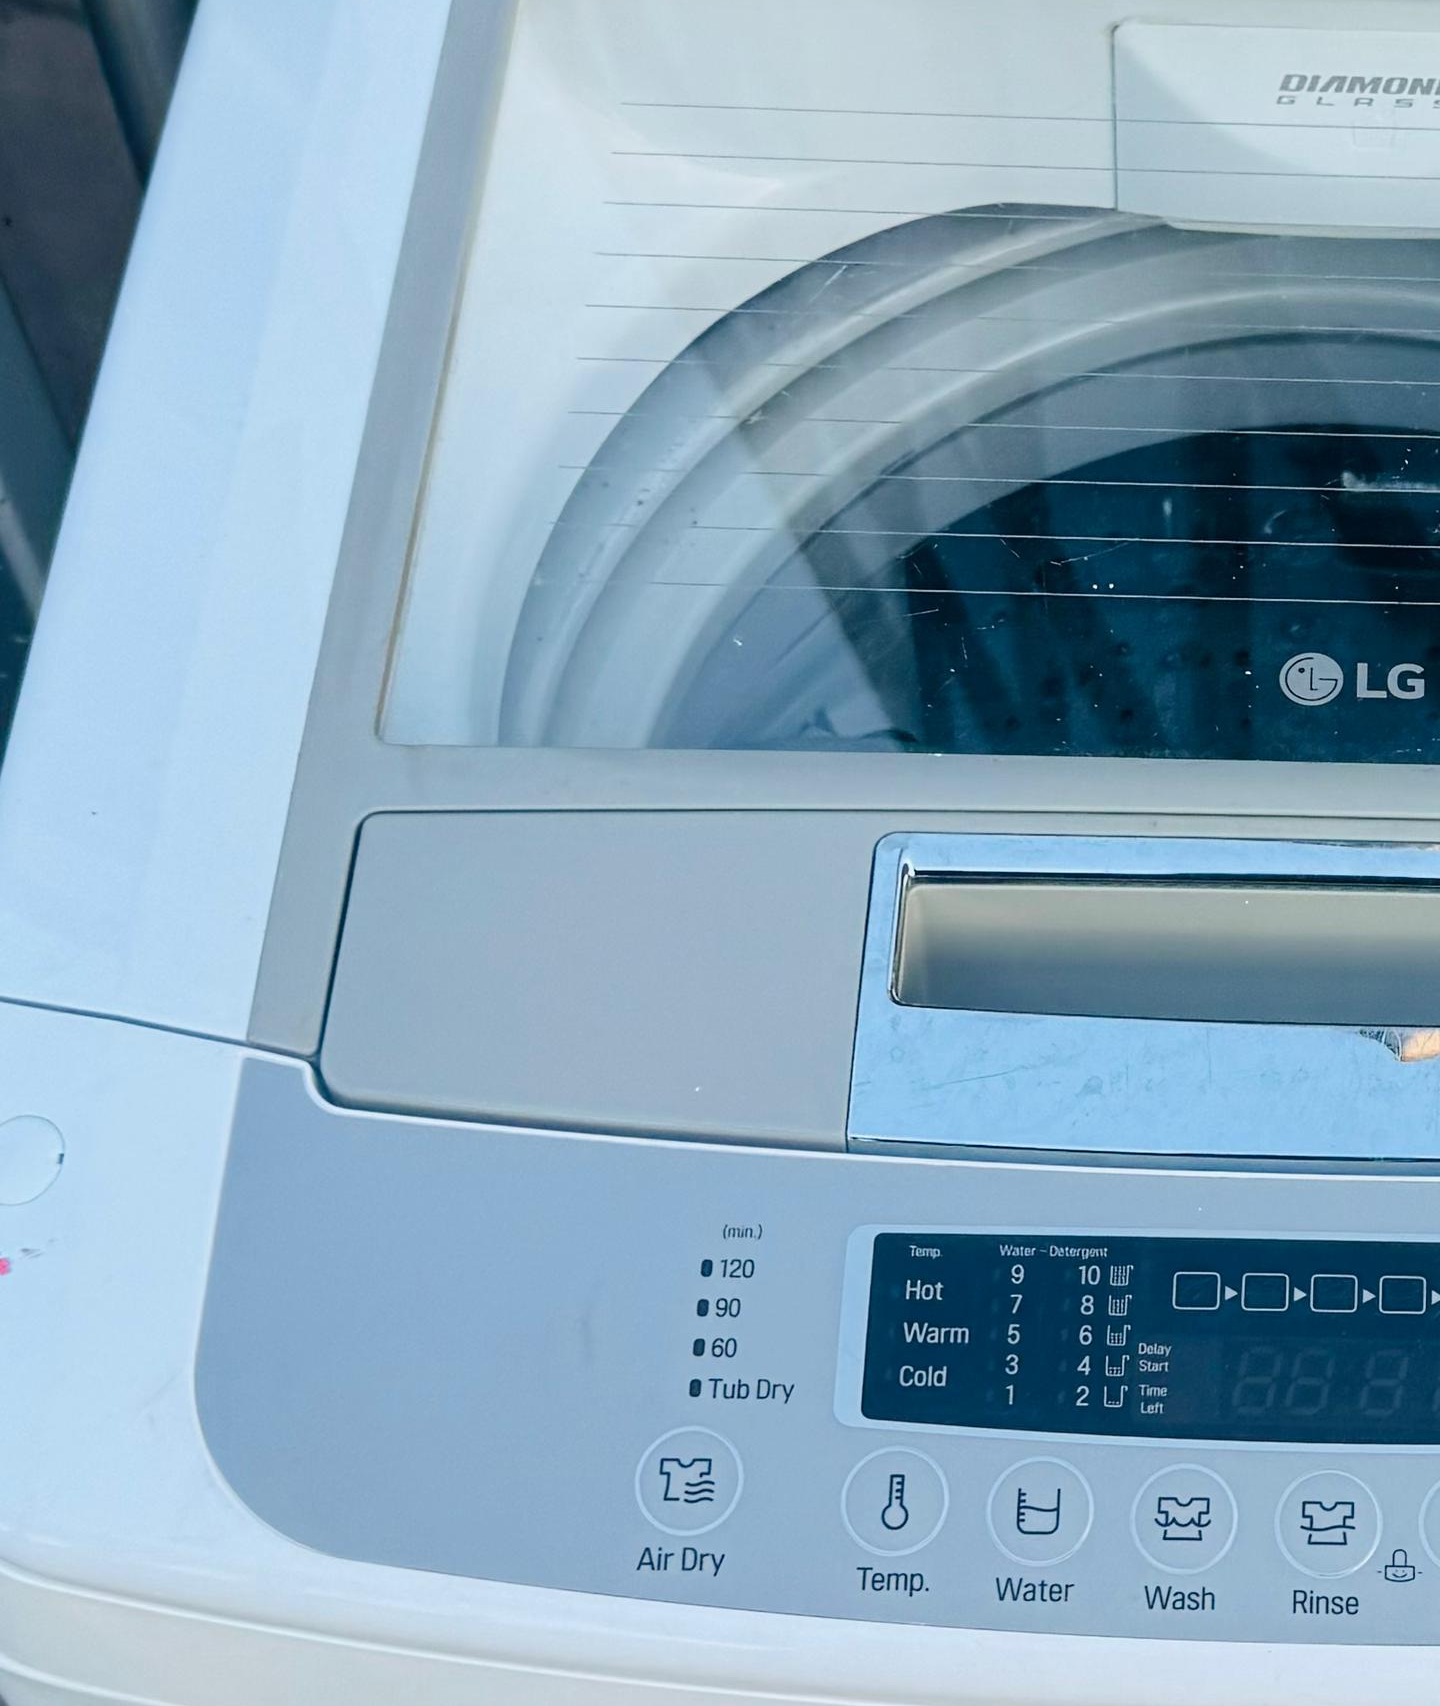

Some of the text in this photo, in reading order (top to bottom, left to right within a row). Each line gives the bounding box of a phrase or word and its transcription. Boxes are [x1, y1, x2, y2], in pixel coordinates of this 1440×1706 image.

[1357, 663, 1424, 700] LG
[723, 1224, 762, 1239] (min.)
[909, 1245, 942, 1259] Temp.
[1000, 1245, 1036, 1256] Water
[1049, 1245, 1108, 1258] Detergent
[721, 1259, 754, 1278] 120
[1011, 1264, 1024, 1284] 9
[1079, 1266, 1100, 1285] 10
[906, 1280, 943, 1300] Hot
[716, 1298, 741, 1317] 90
[1011, 1294, 1022, 1313] 7
[1081, 1295, 1094, 1315] 8
[904, 1322, 969, 1343] Warm
[1008, 1324, 1020, 1344] 5
[1079, 1325, 1092, 1345] 6
[712, 1338, 737, 1358] 60
[1138, 1343, 1172, 1357] Delay
[1005, 1354, 1018, 1374] 3
[1077, 1356, 1090, 1375] 4
[1139, 1360, 1169, 1373] Start
[900, 1366, 947, 1386] Cold
[709, 1378, 794, 1404] Tub Dry
[1006, 1385, 1013, 1405] 1
[1076, 1386, 1089, 1406] 2
[1139, 1385, 1167, 1396] Time
[1141, 1402, 1163, 1414] Left
[637, 1547, 725, 1577] Air Dry
[857, 1567, 929, 1597] Temp.
[996, 1578, 1074, 1602] Water
[1145, 1586, 1215, 1610] Wash
[1293, 1590, 1359, 1615] Rinse
